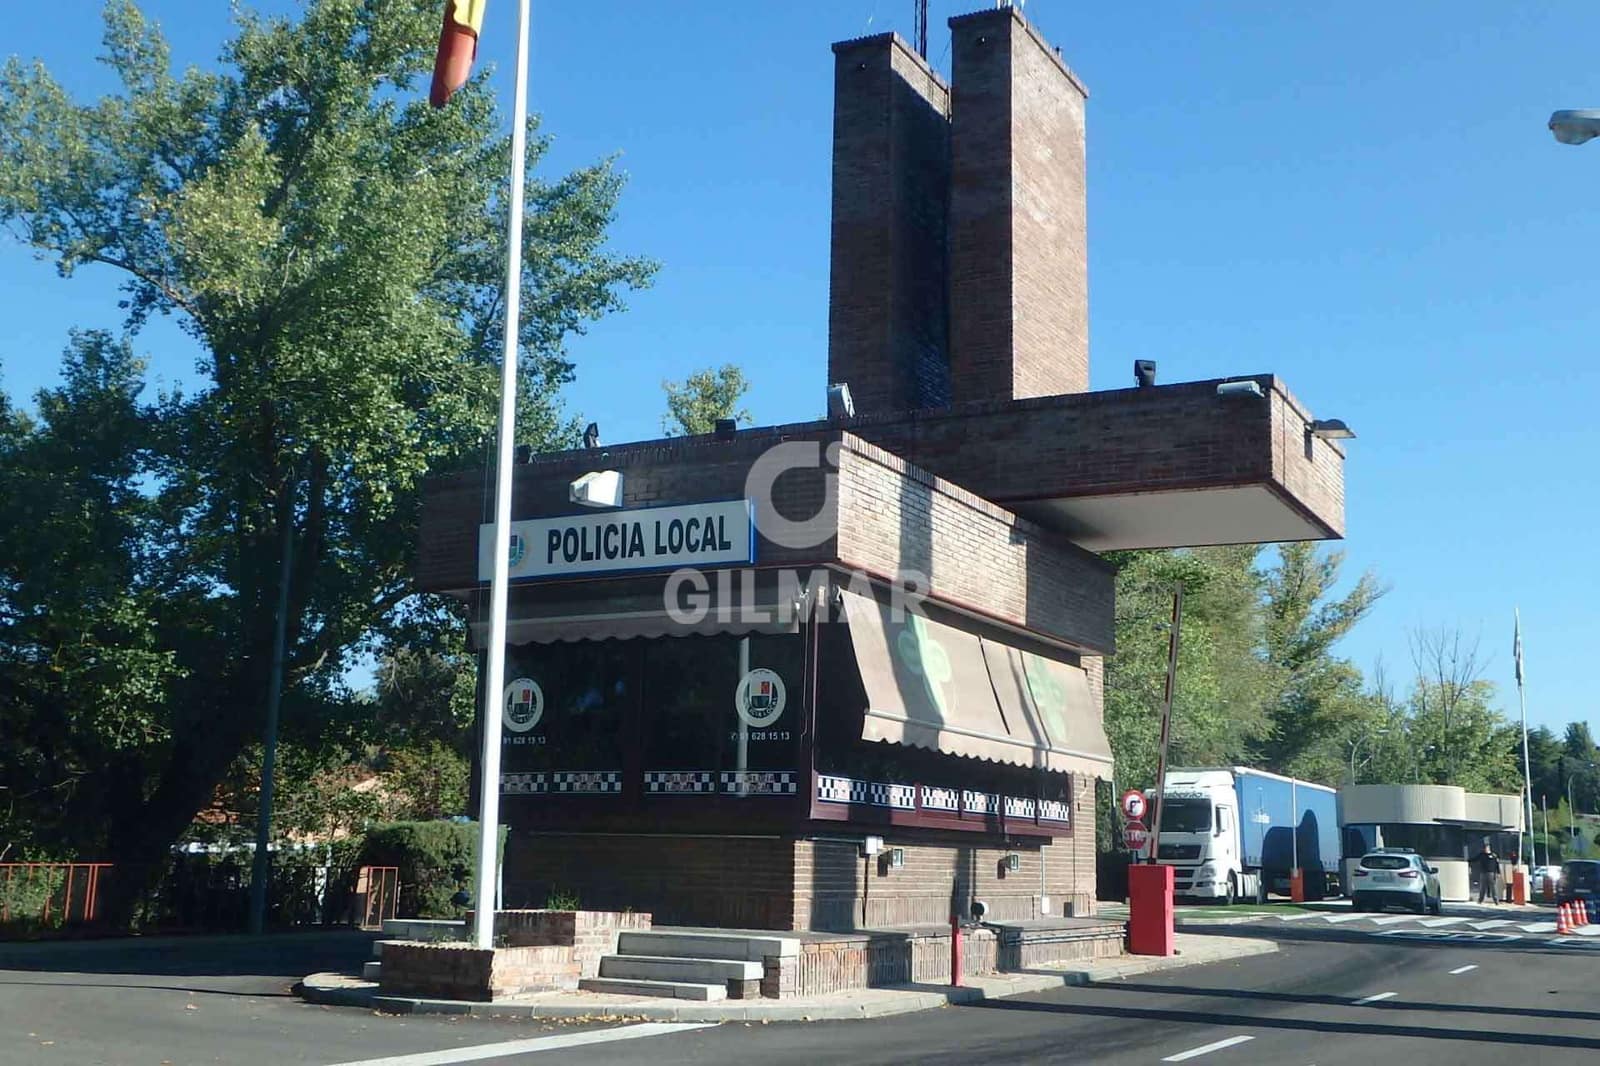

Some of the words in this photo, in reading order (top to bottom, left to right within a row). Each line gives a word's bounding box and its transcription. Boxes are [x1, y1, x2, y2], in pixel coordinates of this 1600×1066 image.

[547, 523, 645, 564] POLICIA
[655, 516, 731, 556] LOCAL
[751, 731, 766, 741] 628
[769, 731, 778, 741] 15
[781, 731, 790, 741] 13
[1125, 831, 1146, 842] STOP
